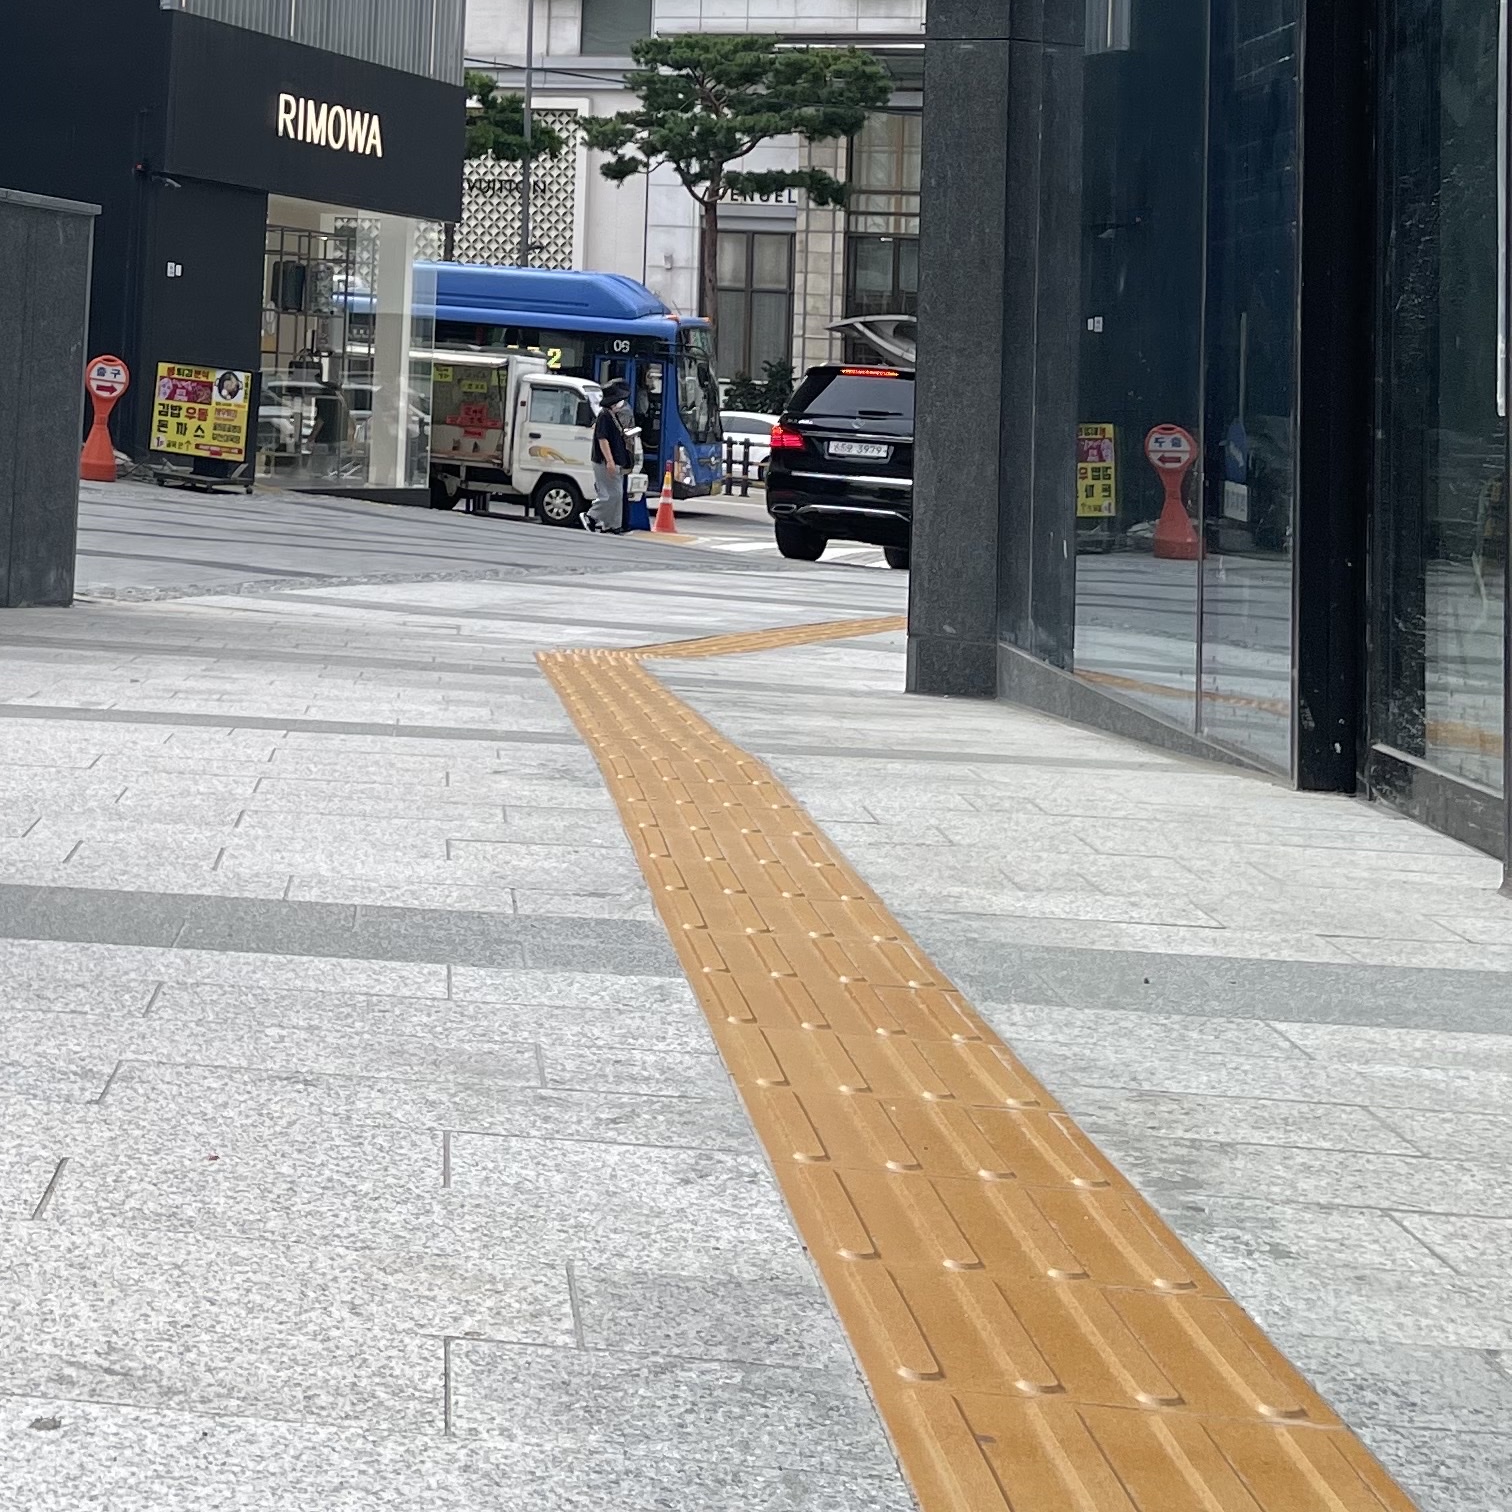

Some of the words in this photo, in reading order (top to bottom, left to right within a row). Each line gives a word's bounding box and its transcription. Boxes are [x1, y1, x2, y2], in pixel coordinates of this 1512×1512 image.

[278, 92, 383, 158] RIMOWA
[158, 402, 183, 419] 김밥
[185, 406, 209, 422] 우동
